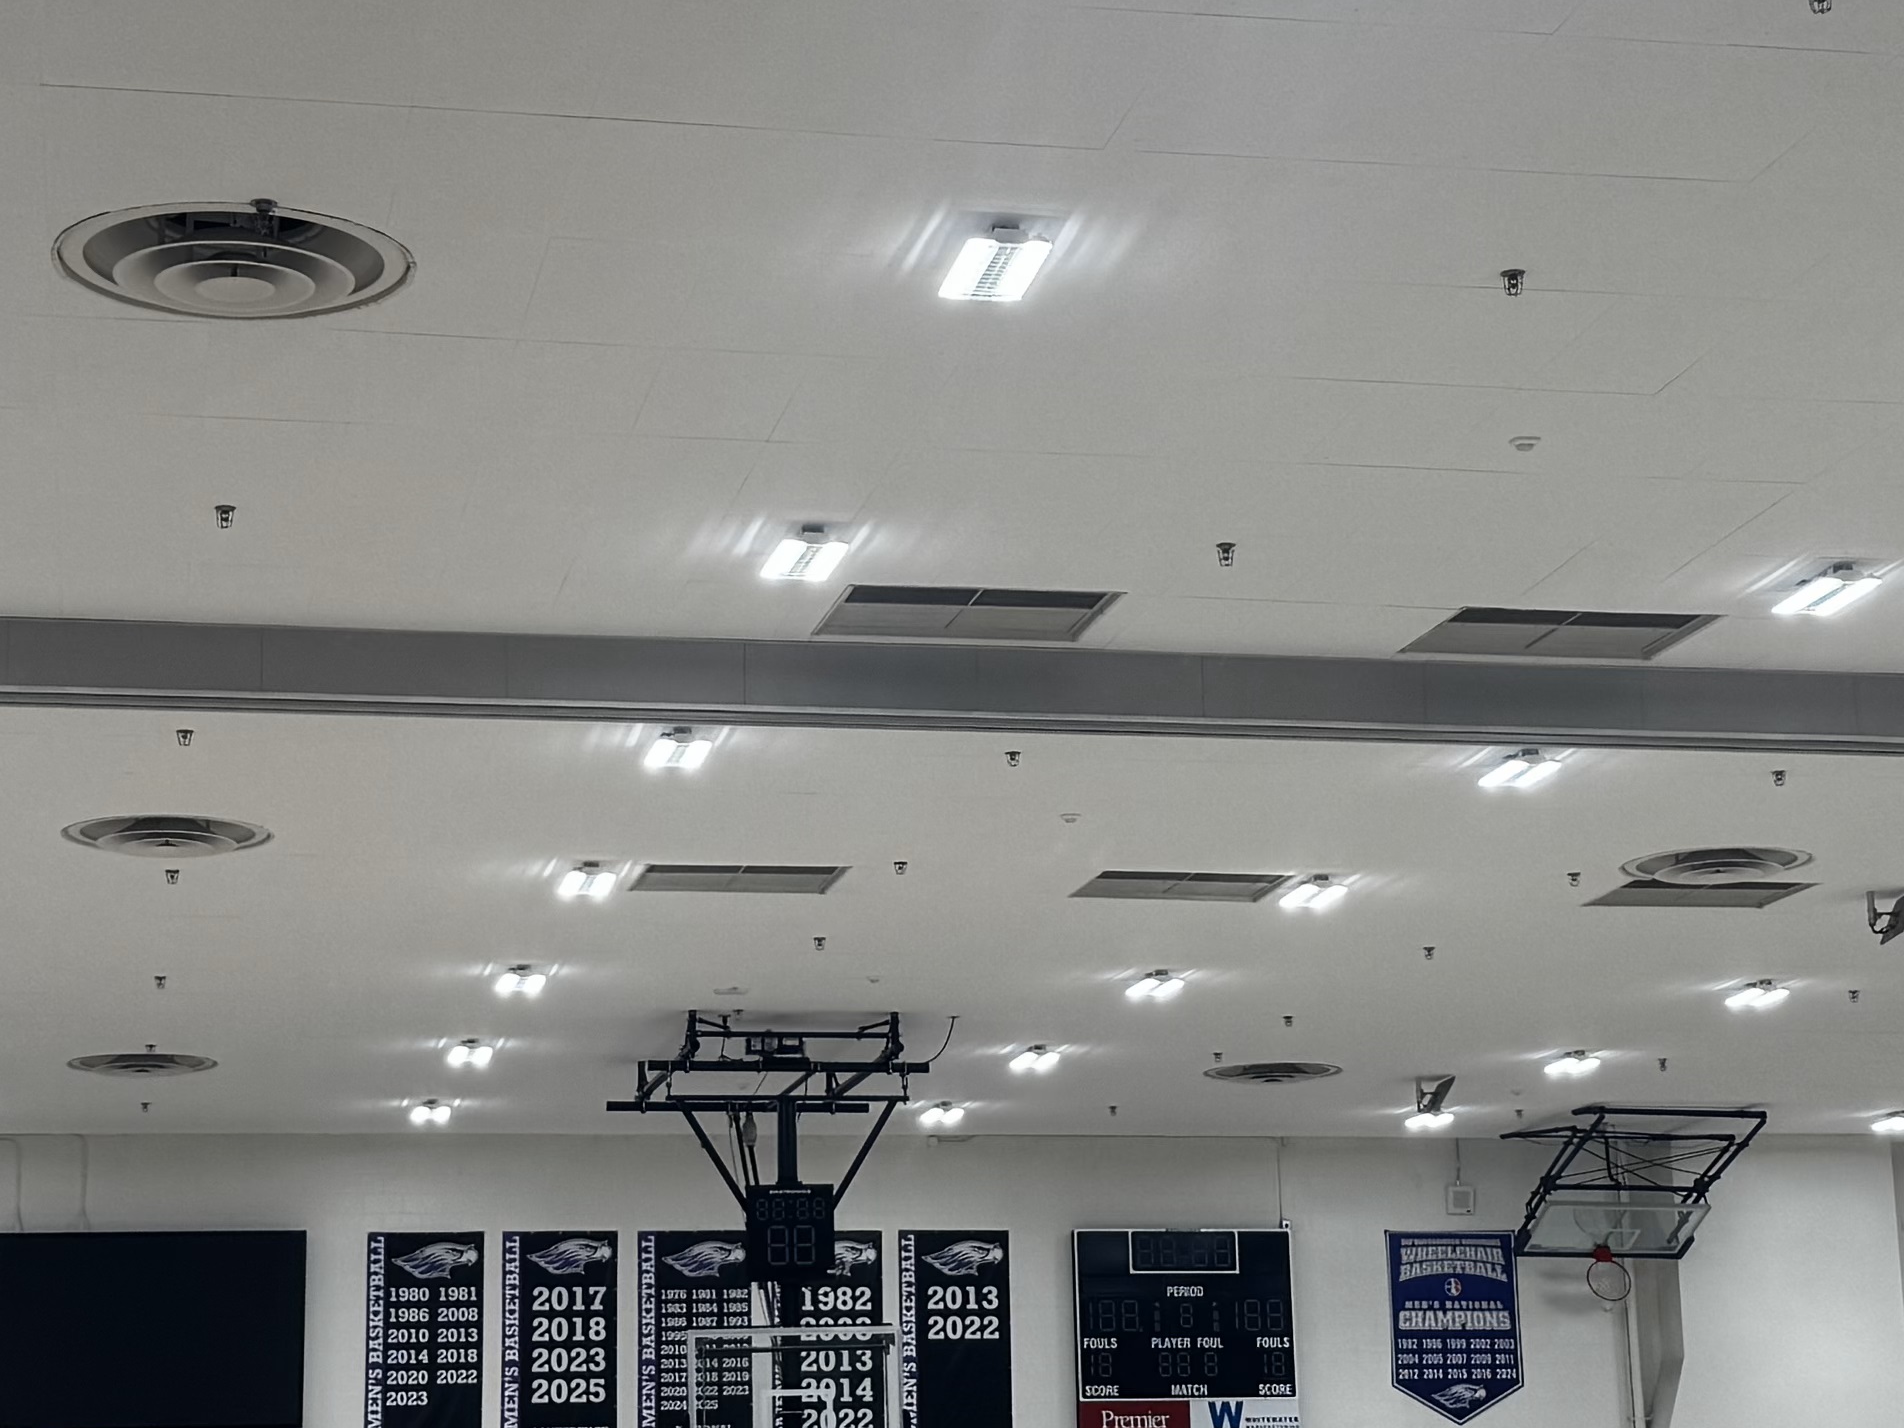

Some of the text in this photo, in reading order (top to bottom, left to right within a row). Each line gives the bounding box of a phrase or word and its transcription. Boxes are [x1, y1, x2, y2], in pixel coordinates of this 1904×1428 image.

[1400, 1246, 1506, 1265] WHEELCHAIR
[1399, 1260, 1508, 1282] BASKETBALL
[369, 1236, 384, 1364] BASKETBALL
[389, 1287, 477, 1301] 1980 1981
[505, 1236, 519, 1361] BASKETBALL
[532, 1286, 607, 1311] 2017
[642, 1236, 656, 1360] BASKETBALL
[661, 1289, 687, 1299] 1976
[801, 1286, 872, 1311] 1982
[902, 1234, 916, 1357] BASKETBALL
[927, 1285, 999, 1309] 2013
[1166, 1286, 1204, 1297] PERIOD
[1405, 1300, 1504, 1309] MEN'S NATIONAL
[389, 1308, 478, 1322] 1986 2008
[1399, 1310, 1511, 1330] CHAMPIONS
[388, 1328, 478, 1342] 2010 2013
[532, 1317, 606, 1341] 2018
[927, 1315, 999, 1340] 2022
[660, 1344, 687, 1355] 2010
[1083, 1337, 1290, 1349] FOULS PLAYER FOUL FOULS
[387, 1349, 478, 1363] 2014 2018
[531, 1348, 606, 1372] 2023
[660, 1357, 749, 1369] 2013 014 2016
[800, 1350, 873, 1372] 2013
[386, 1370, 478, 1384] 2020 2022
[660, 1372, 687, 1382] 2017
[696, 1372, 718, 1382] 018
[531, 1378, 606, 1403] 2025
[660, 1386, 687, 1396] 2020
[696, 1385, 718, 1395] 022
[801, 1377, 874, 1402] 2014
[1085, 1384, 1293, 1397] SCORE MATCH SCORE
[386, 1392, 428, 1406] 2023
[696, 1400, 718, 1409] 025
[1101, 1410, 1170, 1428] Premier
